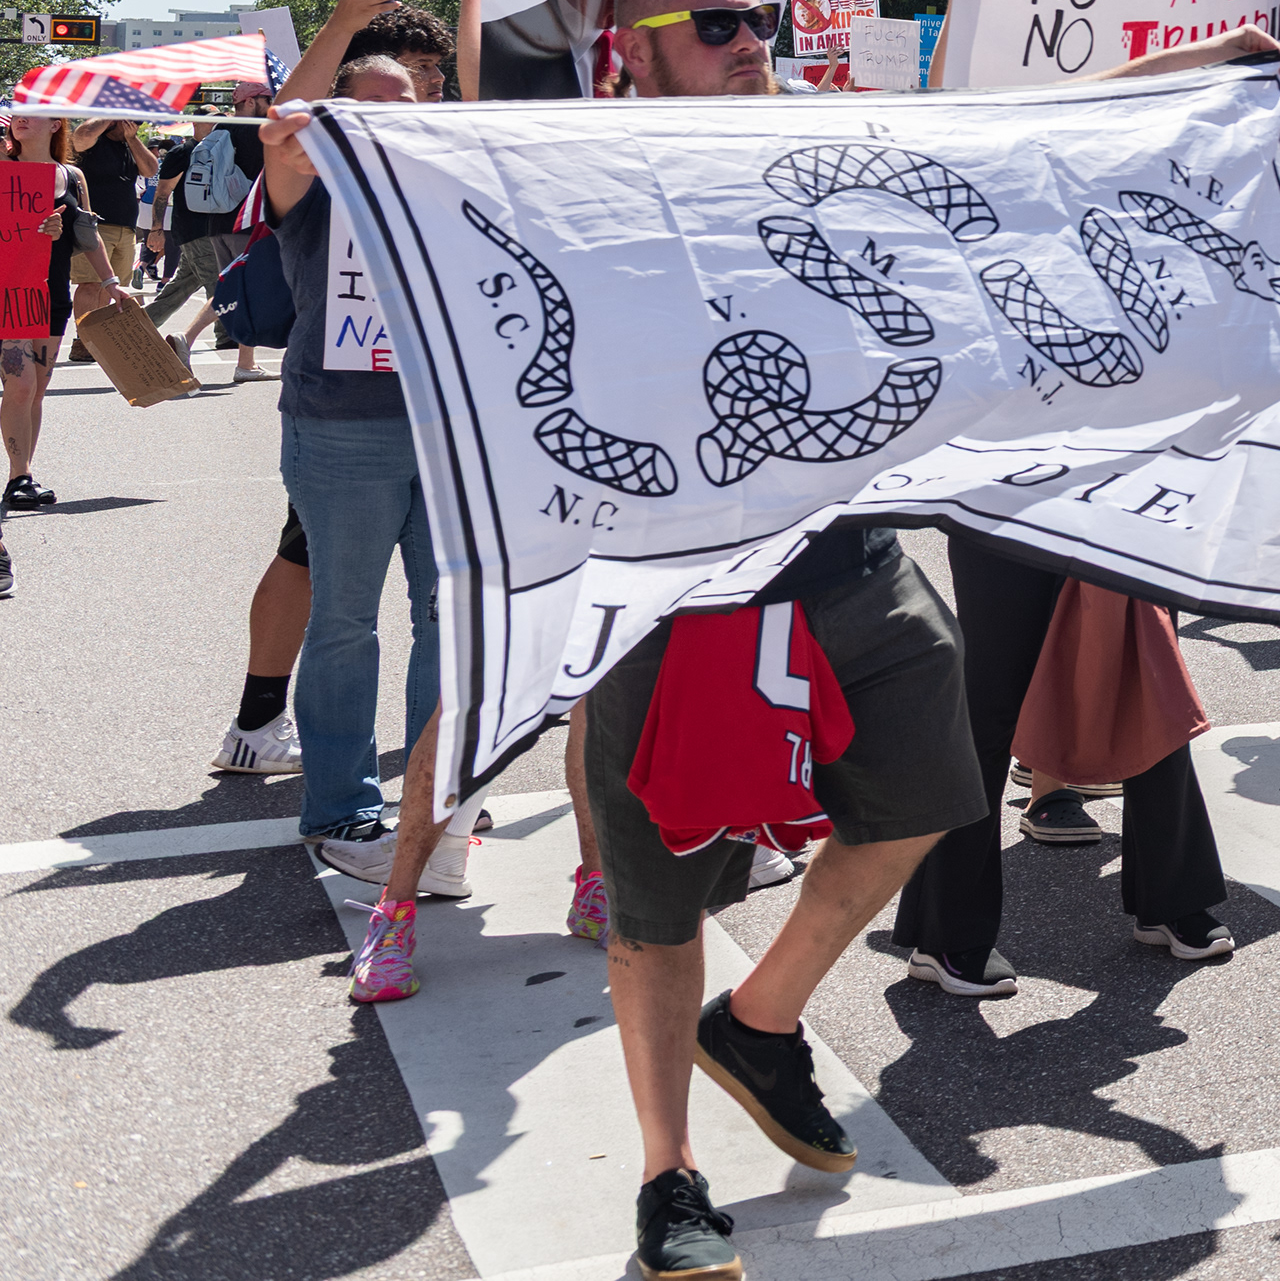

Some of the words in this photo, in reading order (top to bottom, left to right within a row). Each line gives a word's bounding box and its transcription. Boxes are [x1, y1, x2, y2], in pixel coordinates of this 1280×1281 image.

[800, 36, 815, 51] IN
[865, 25, 906, 47] FUCK
[1022, 9, 1094, 74] NO
[2, 176, 47, 214] the
[477, 272, 530, 350] S.C.
[539, 485, 620, 531] N.C.
